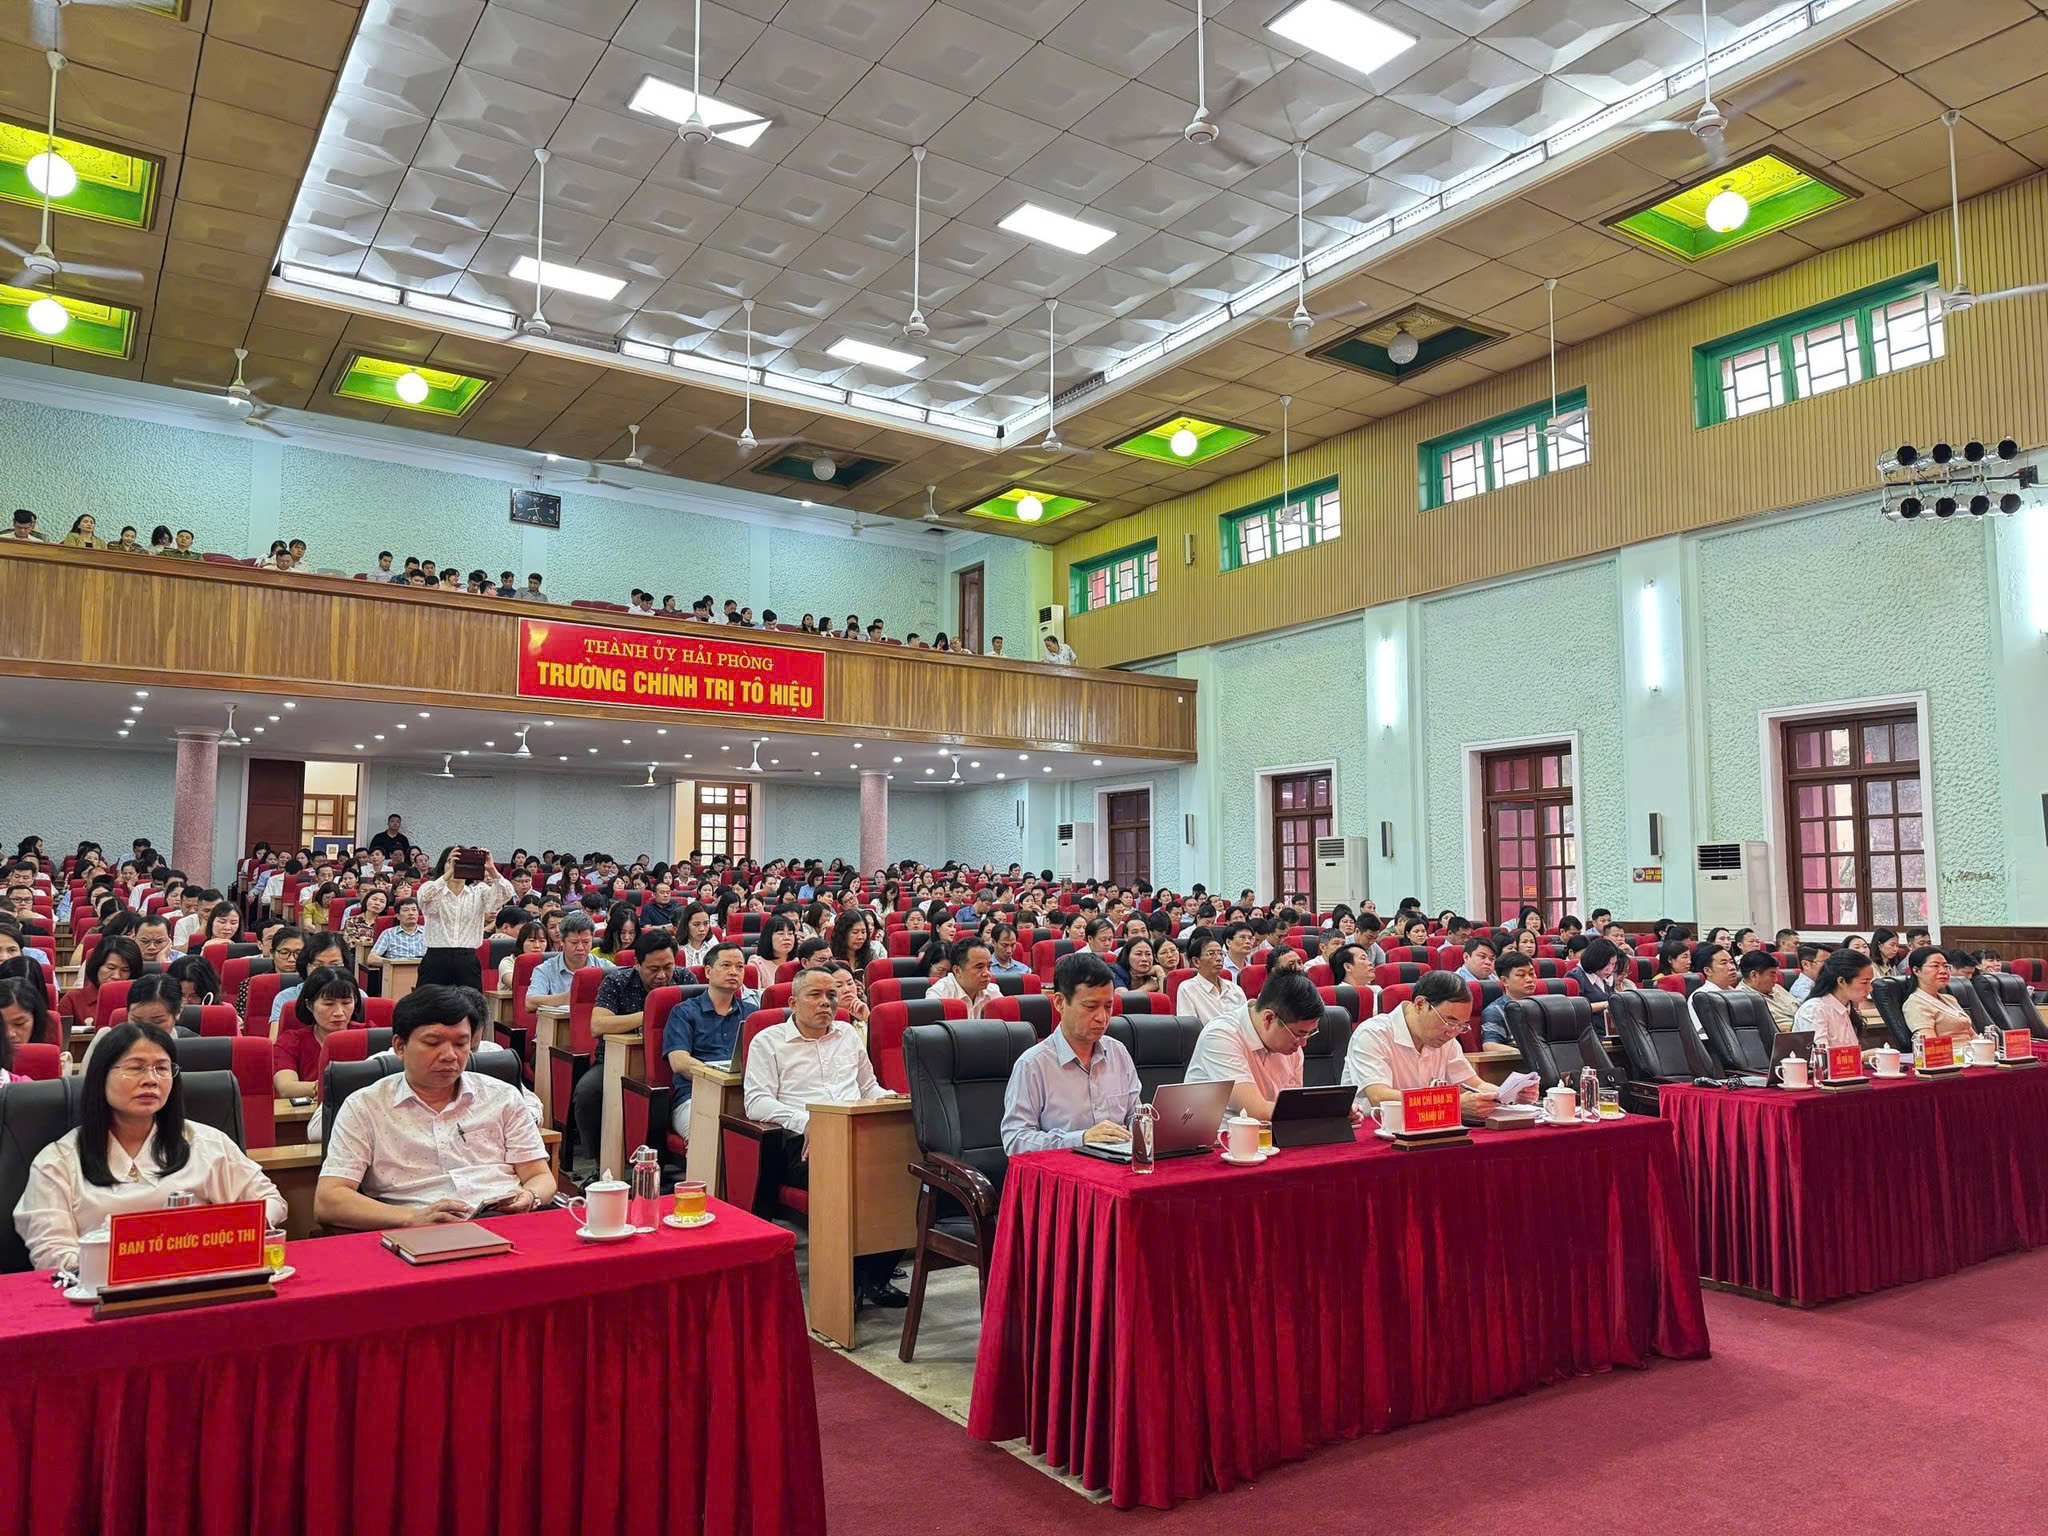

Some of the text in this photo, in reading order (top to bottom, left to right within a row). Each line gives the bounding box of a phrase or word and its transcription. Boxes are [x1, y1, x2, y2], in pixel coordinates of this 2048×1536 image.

[584, 636, 774, 671] THÀNH ỦY HẢI PHÒNG
[537, 657, 813, 712] TRƯỜNG CHÍNH TRỊ TÔ HIỆU
[119, 1228, 256, 1256] BAN TỔ CHỨC CUỘC THI
